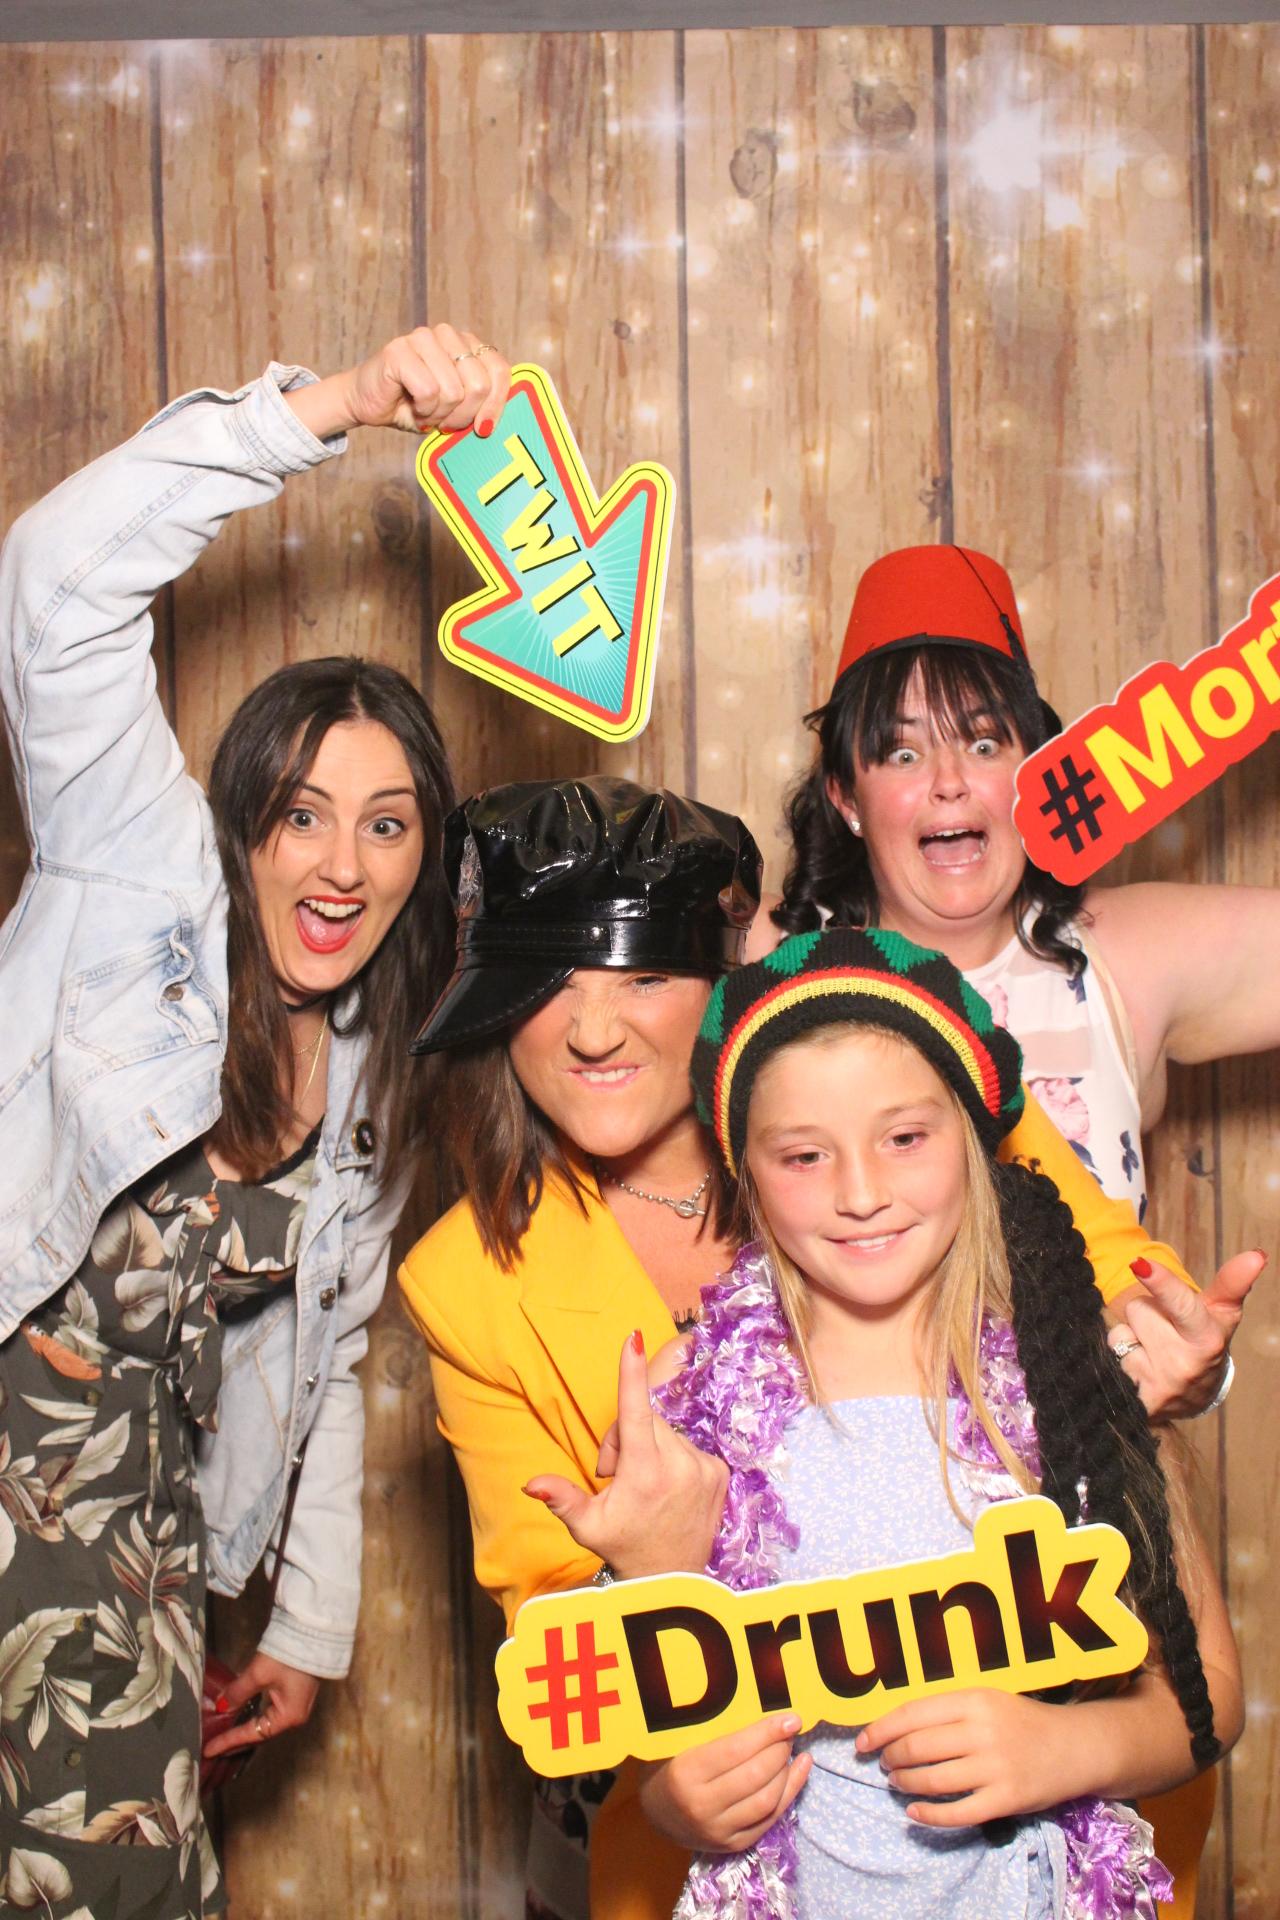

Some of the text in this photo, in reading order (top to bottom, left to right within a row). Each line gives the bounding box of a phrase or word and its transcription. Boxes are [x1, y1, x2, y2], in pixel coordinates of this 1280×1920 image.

[476, 433, 625, 658] TWIT
[1039, 599, 1280, 855] #Mor
[525, 1529, 1118, 1750] #Drunk
